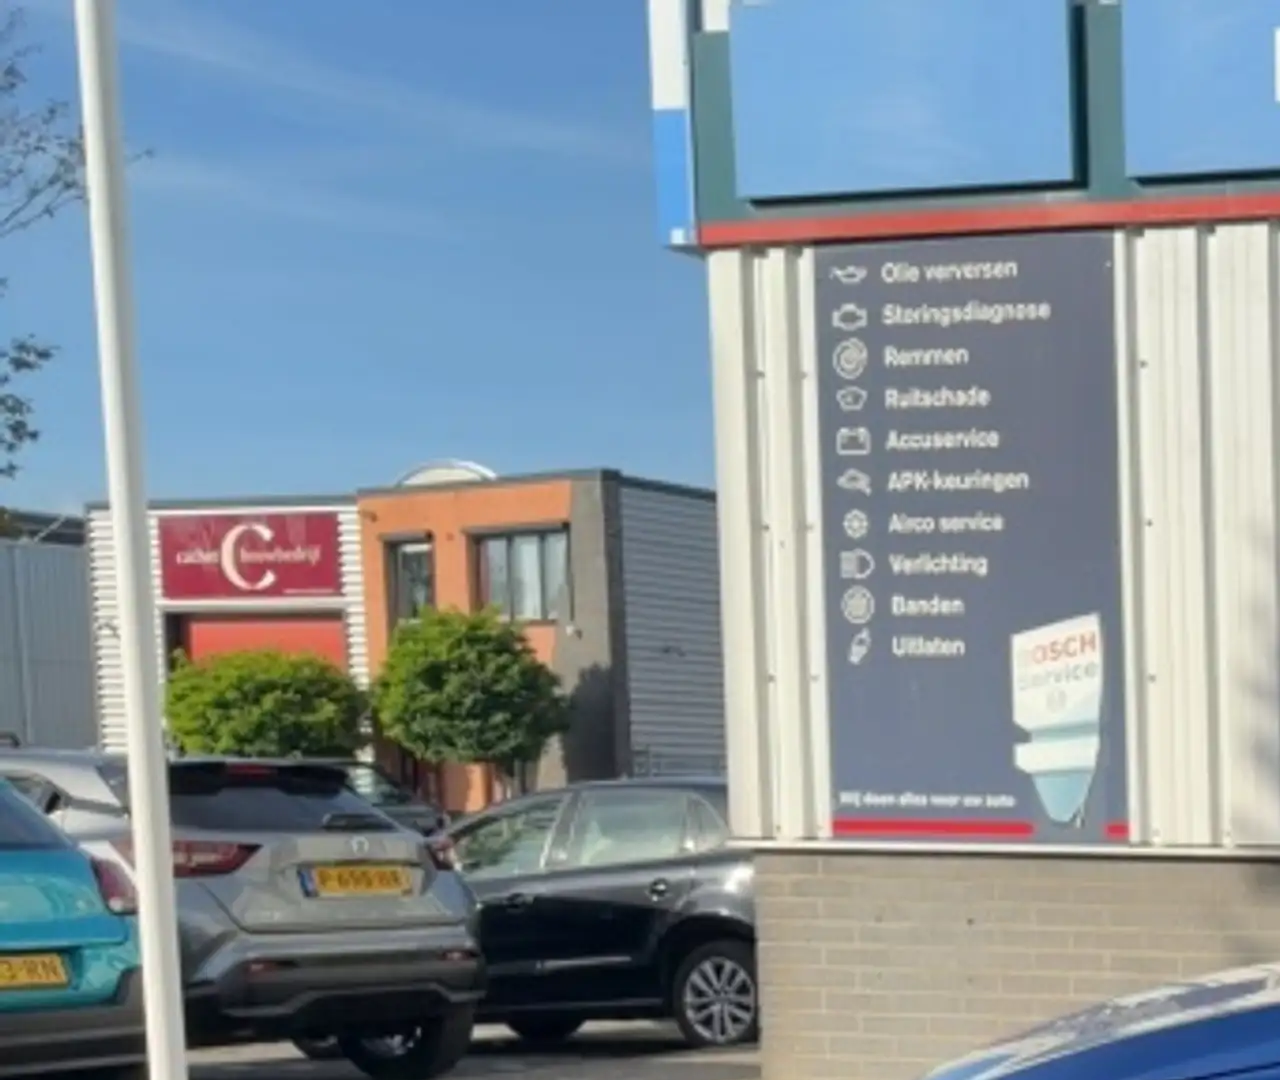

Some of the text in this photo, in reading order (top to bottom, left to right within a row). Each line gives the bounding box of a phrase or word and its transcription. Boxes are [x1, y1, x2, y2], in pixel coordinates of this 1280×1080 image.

[880, 261, 920, 283] Olie
[884, 345, 969, 367] Remmen
[884, 385, 991, 409] Ruitschade
[885, 428, 1000, 450] Accuservice
[887, 469, 1029, 493] APK-keuringen
[888, 512, 1004, 534] Airco service
[889, 553, 988, 576] Verlichting
[891, 594, 964, 616] Banden
[892, 636, 965, 657] Uitlaten
[1016, 632, 1096, 665] OSCH
